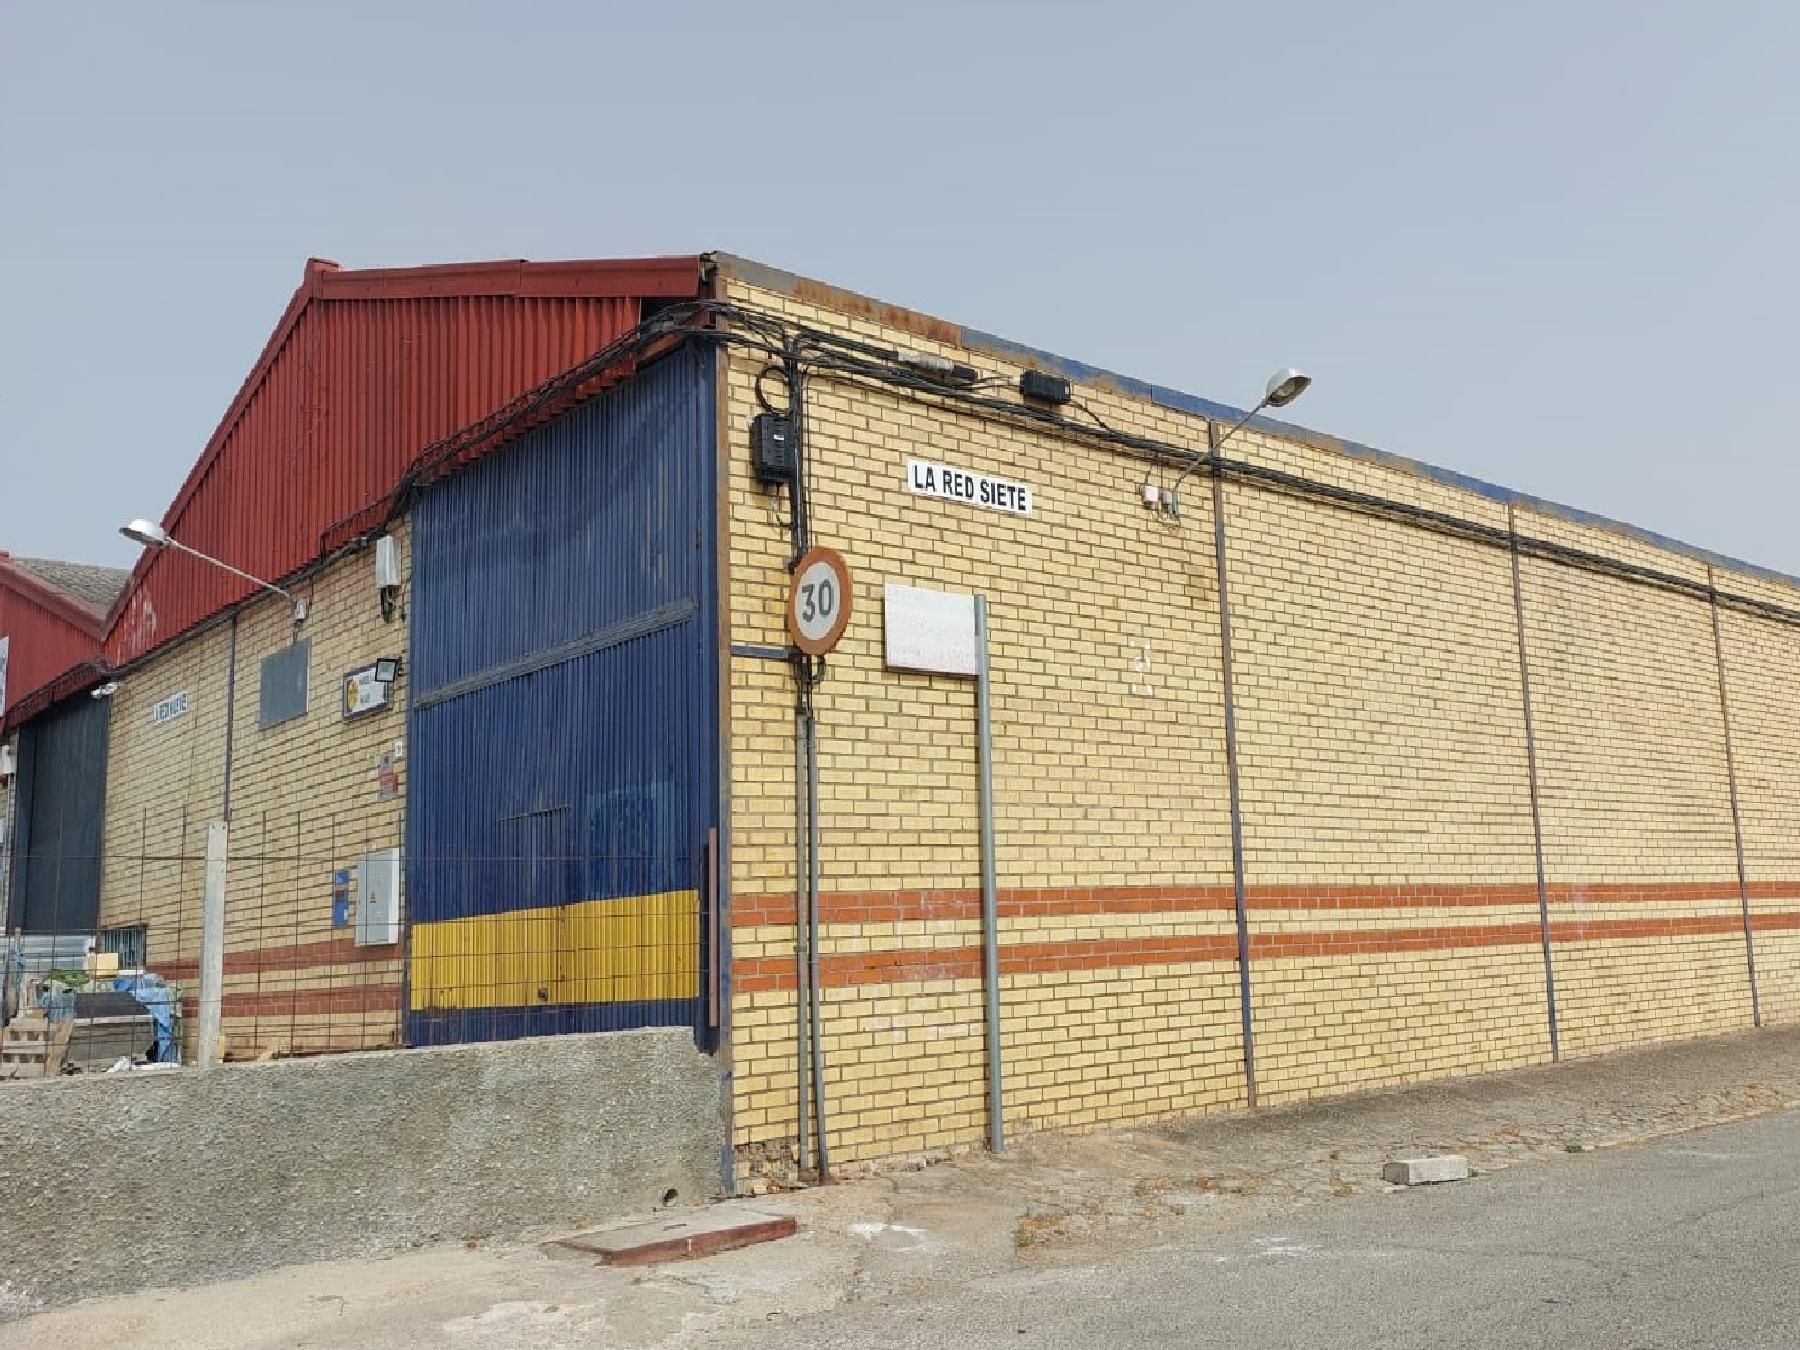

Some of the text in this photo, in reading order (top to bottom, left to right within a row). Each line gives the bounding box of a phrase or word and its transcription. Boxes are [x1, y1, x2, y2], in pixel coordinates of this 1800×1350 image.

[914, 465, 1026, 511] LA RED SIETE
[802, 579, 832, 622] 30
